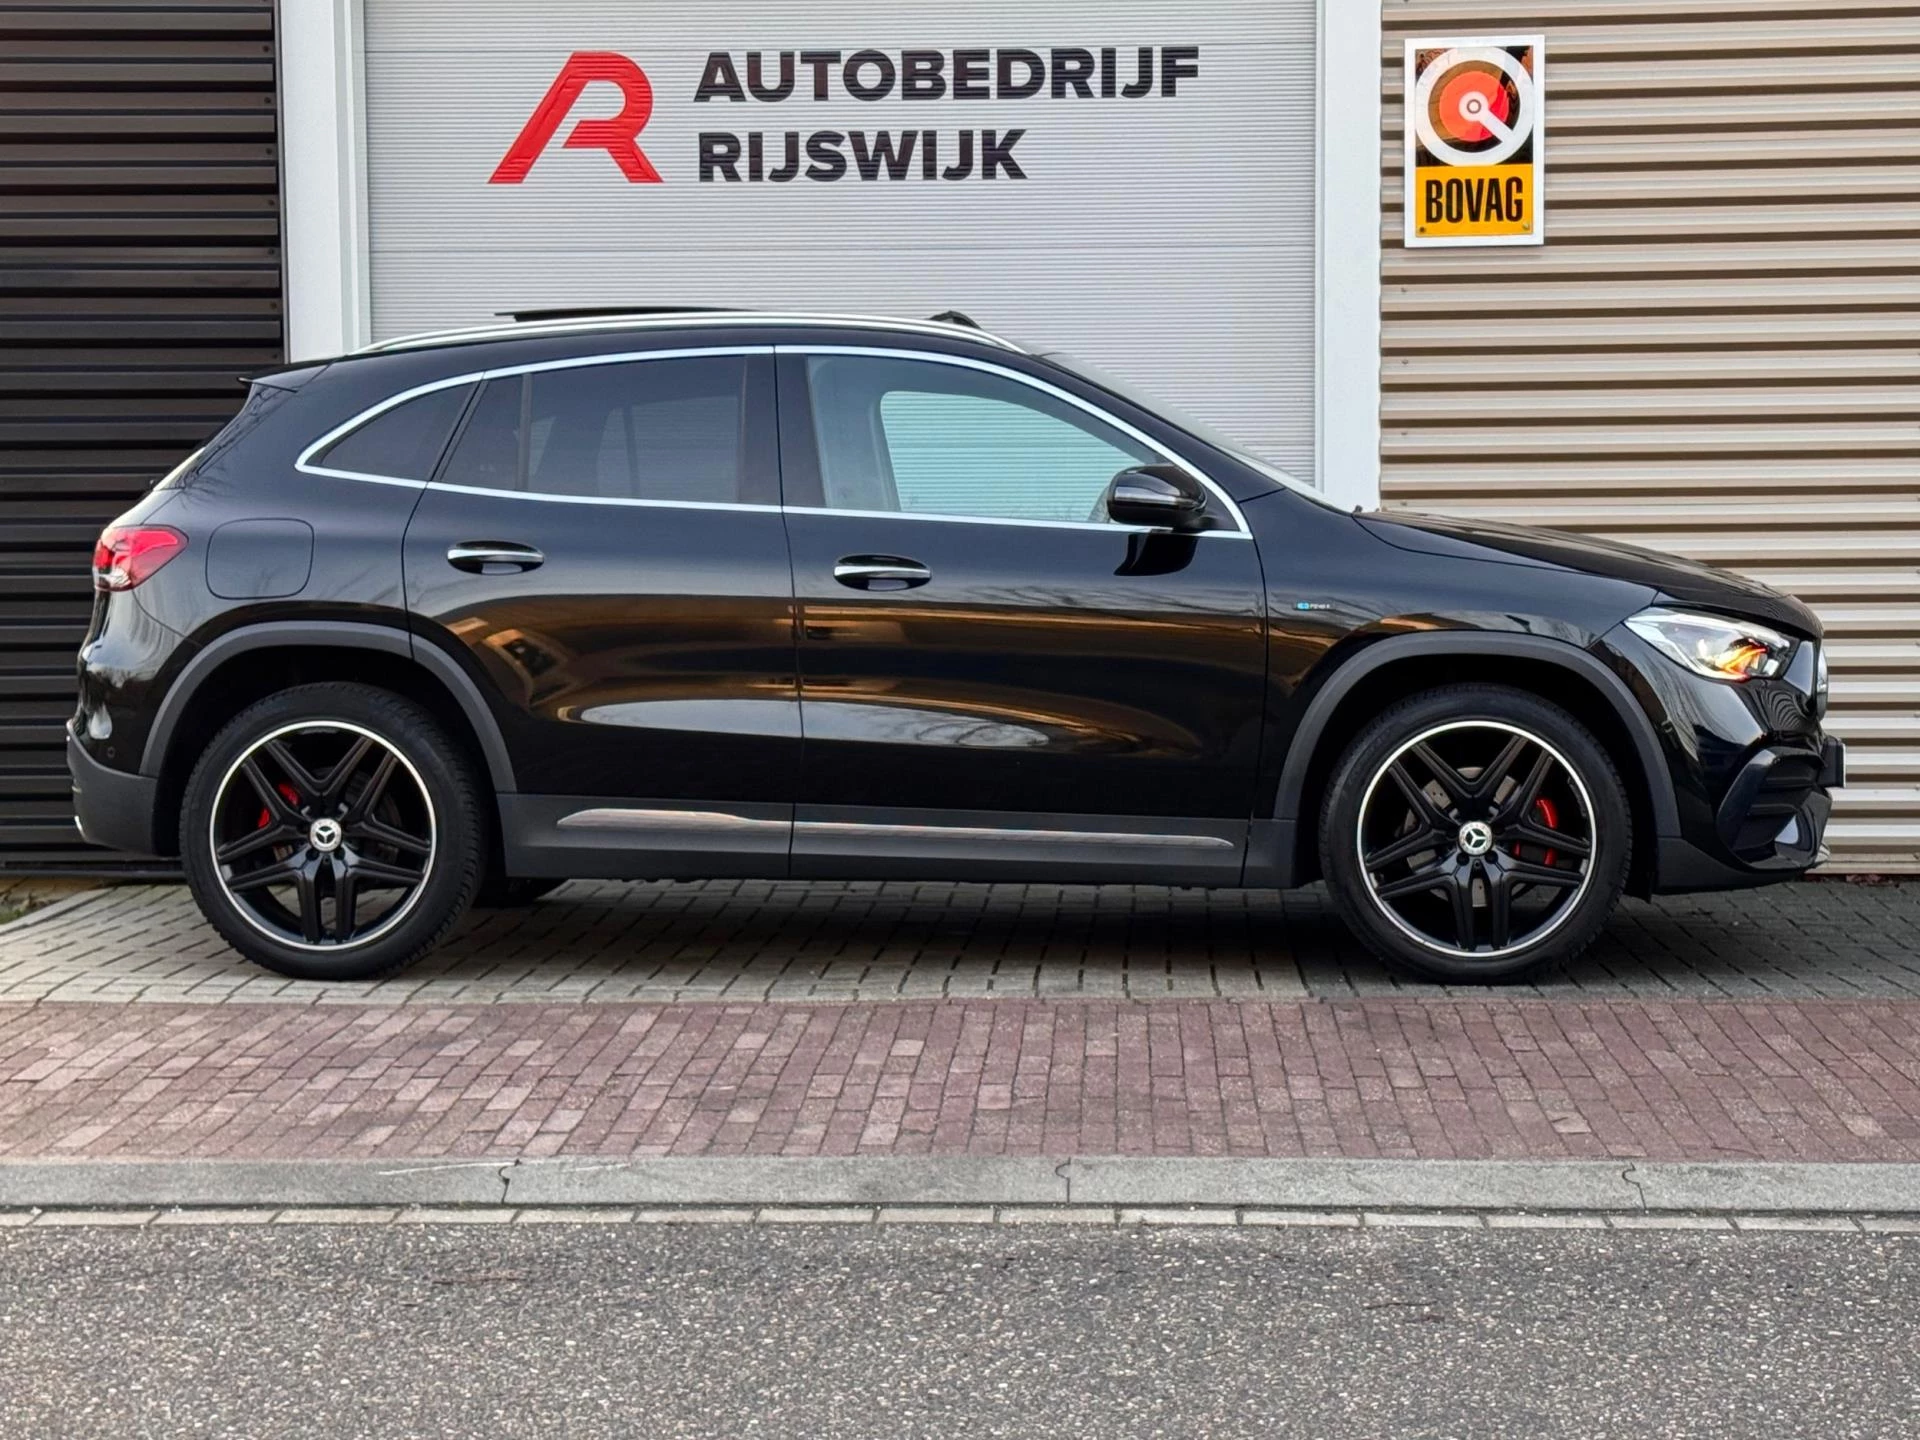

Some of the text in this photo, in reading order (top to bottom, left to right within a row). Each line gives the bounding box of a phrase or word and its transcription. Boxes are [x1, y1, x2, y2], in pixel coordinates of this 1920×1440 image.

[694, 47, 1198, 102] AUTOBEDRIJF
[699, 130, 1026, 182] RIJSWIJK
[1425, 176, 1523, 224] BOVAG
